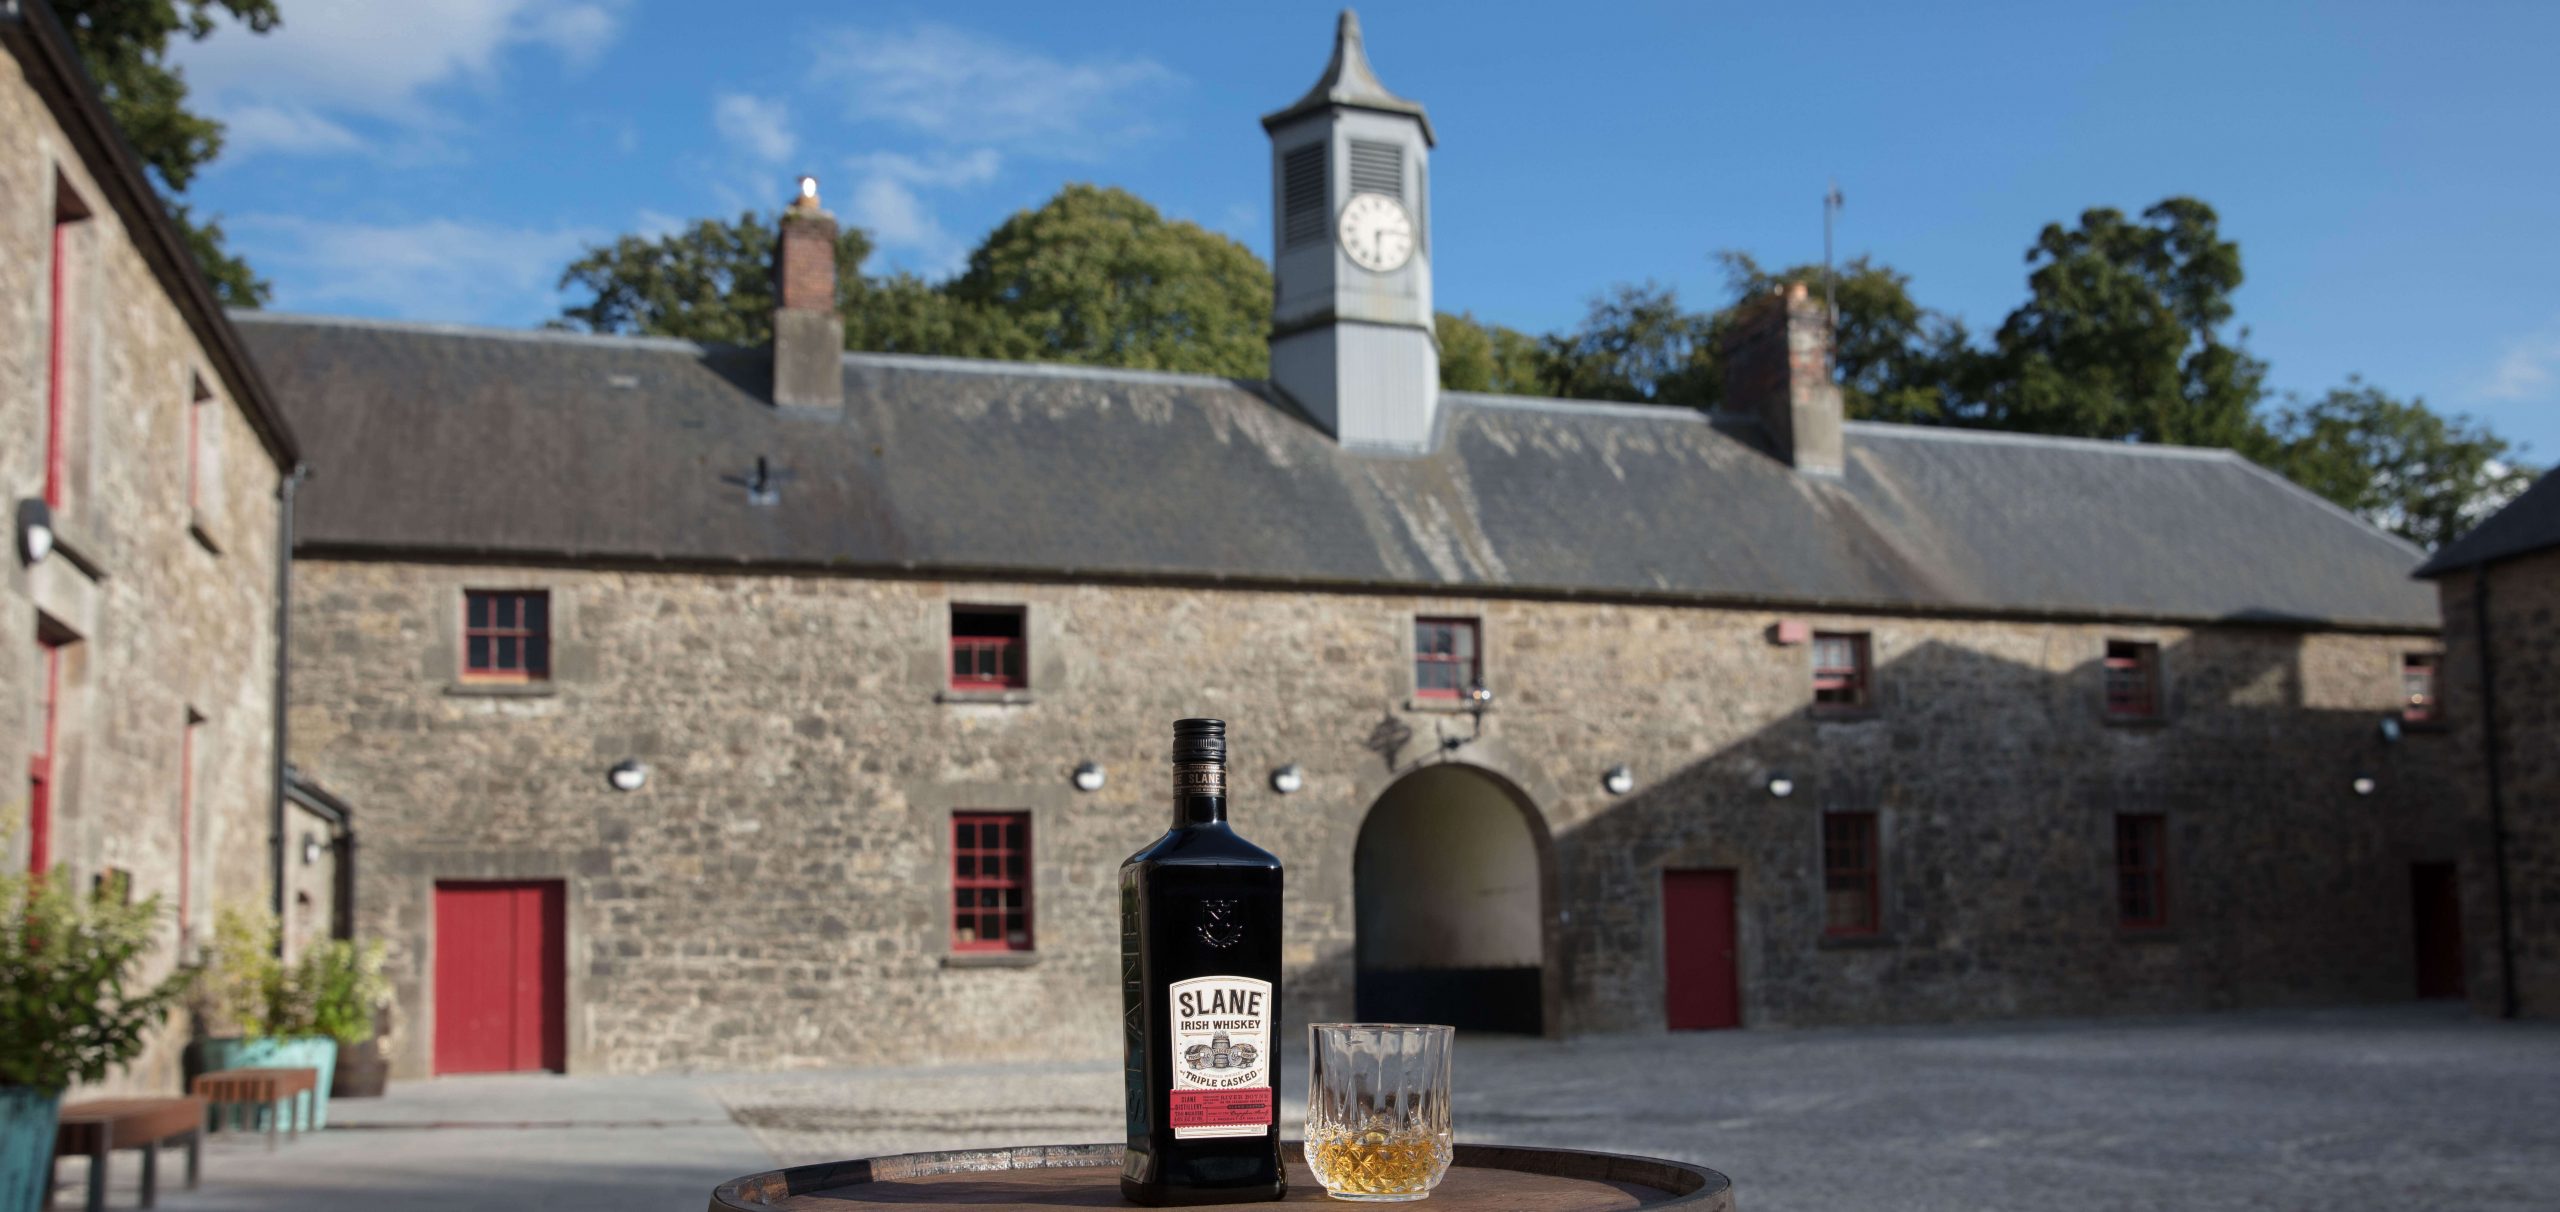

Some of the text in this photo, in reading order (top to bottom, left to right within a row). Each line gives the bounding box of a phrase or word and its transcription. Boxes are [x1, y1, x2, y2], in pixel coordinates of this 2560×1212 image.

[1189, 773, 1221, 784] SLANE
[1179, 989, 1262, 1018] SLANE
[1180, 1019, 1261, 1030] IRISH WHISKEY
[1185, 1070, 1218, 1088] TRIPLE
[1220, 1070, 1258, 1088] CASKED
